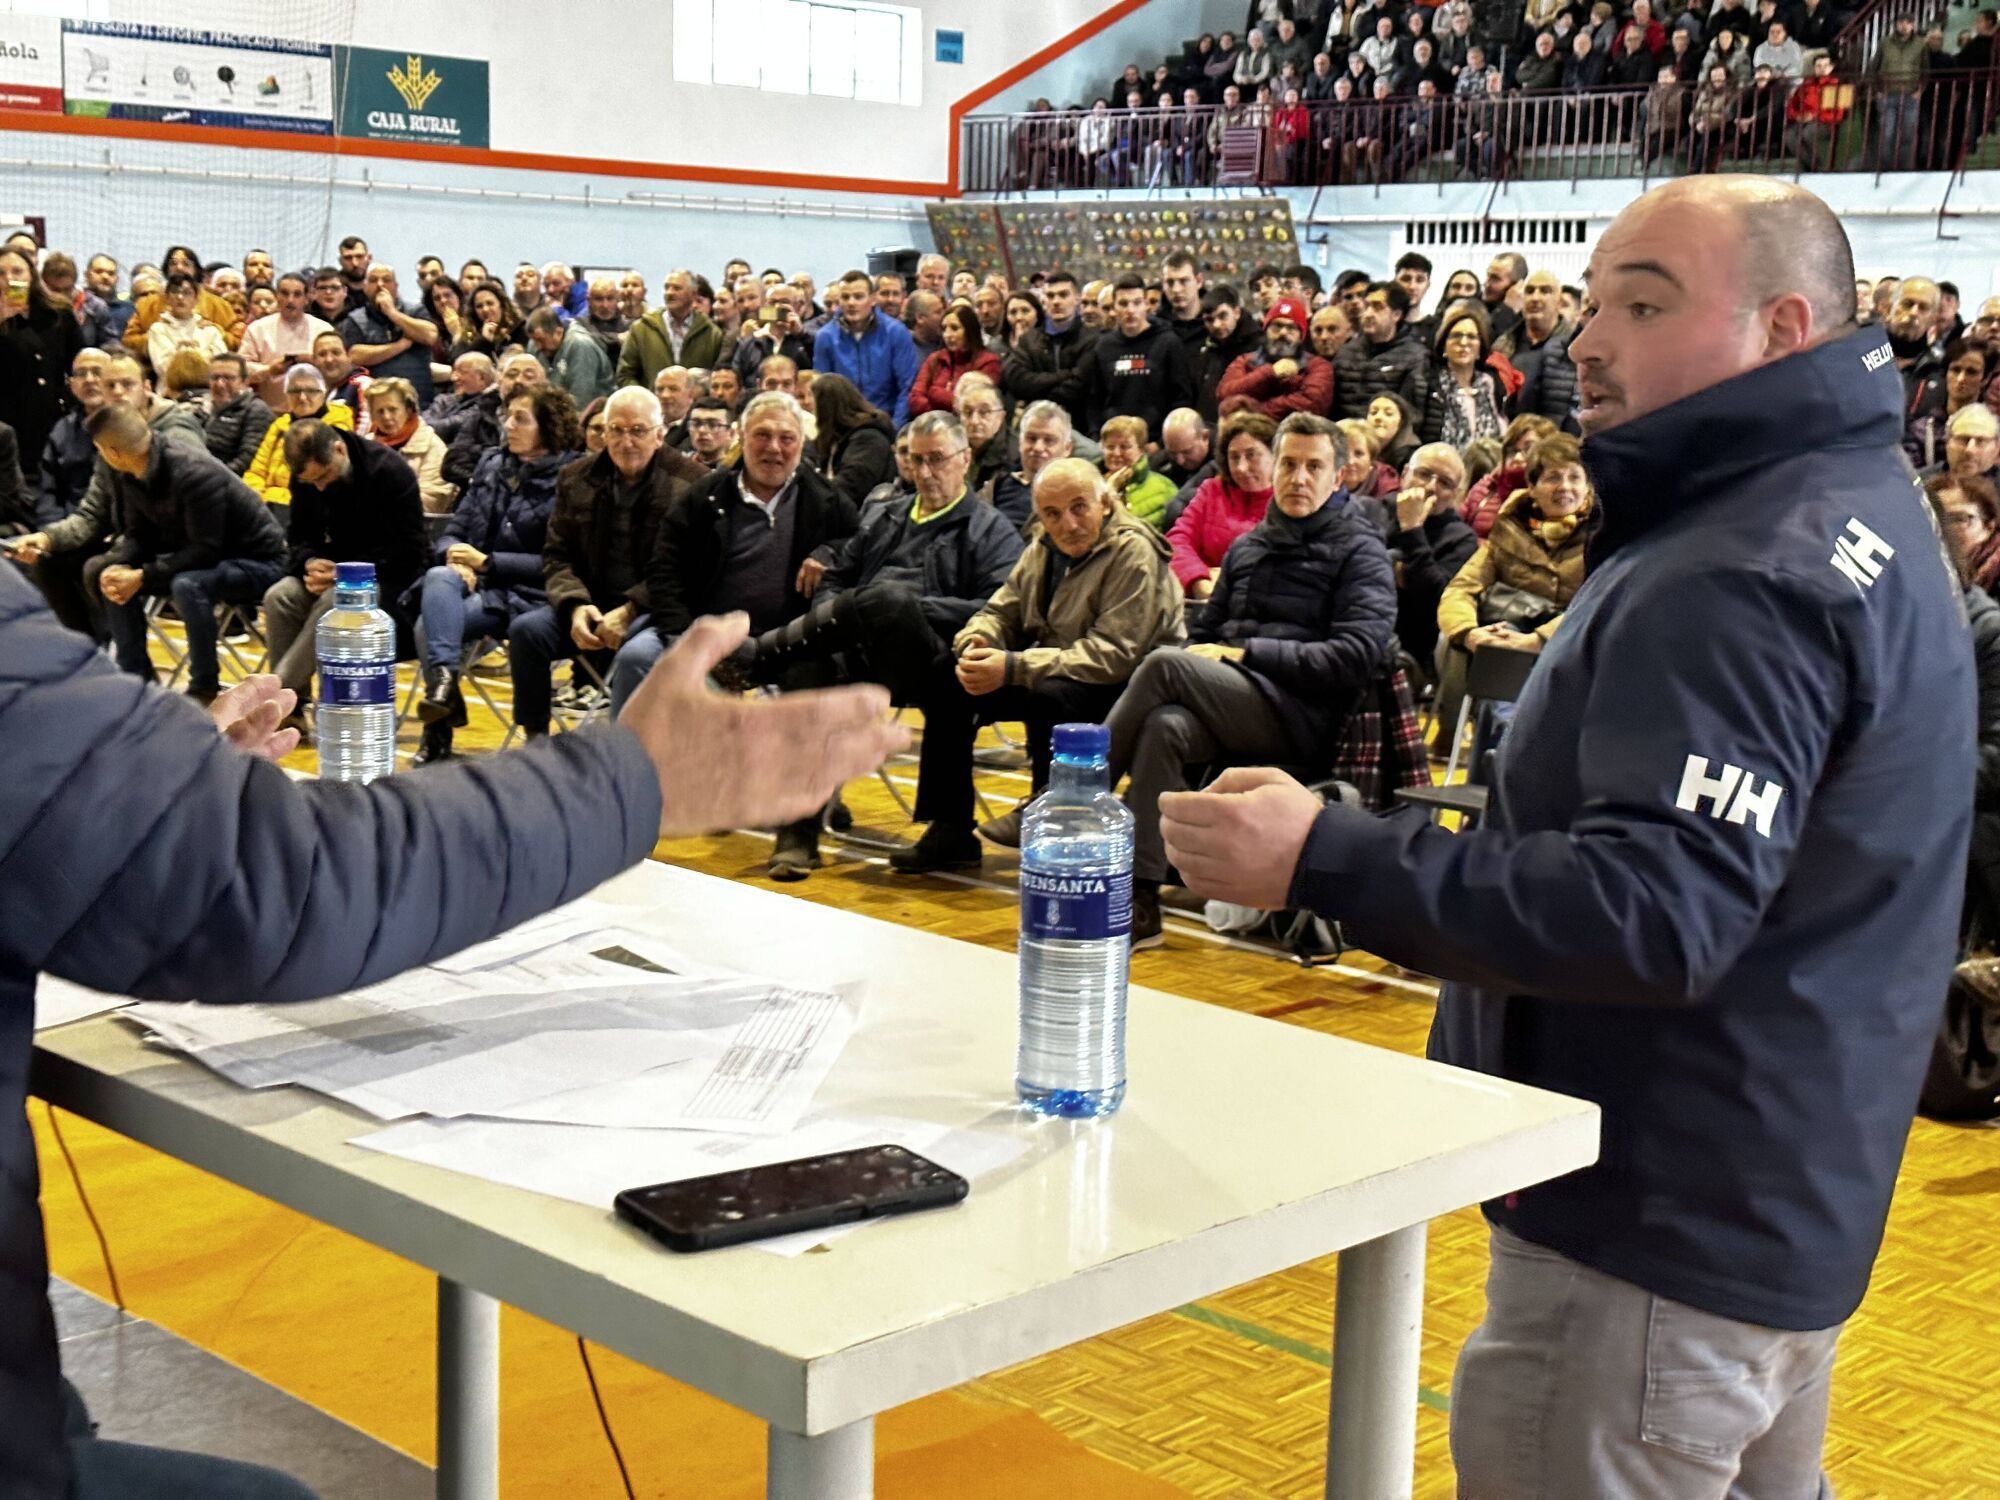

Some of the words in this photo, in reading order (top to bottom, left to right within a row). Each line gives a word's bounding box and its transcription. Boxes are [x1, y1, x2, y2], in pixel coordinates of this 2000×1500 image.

[367, 111, 407, 131] CAJA
[409, 114, 462, 135] RURAL
[1675, 753, 1783, 838] HH
